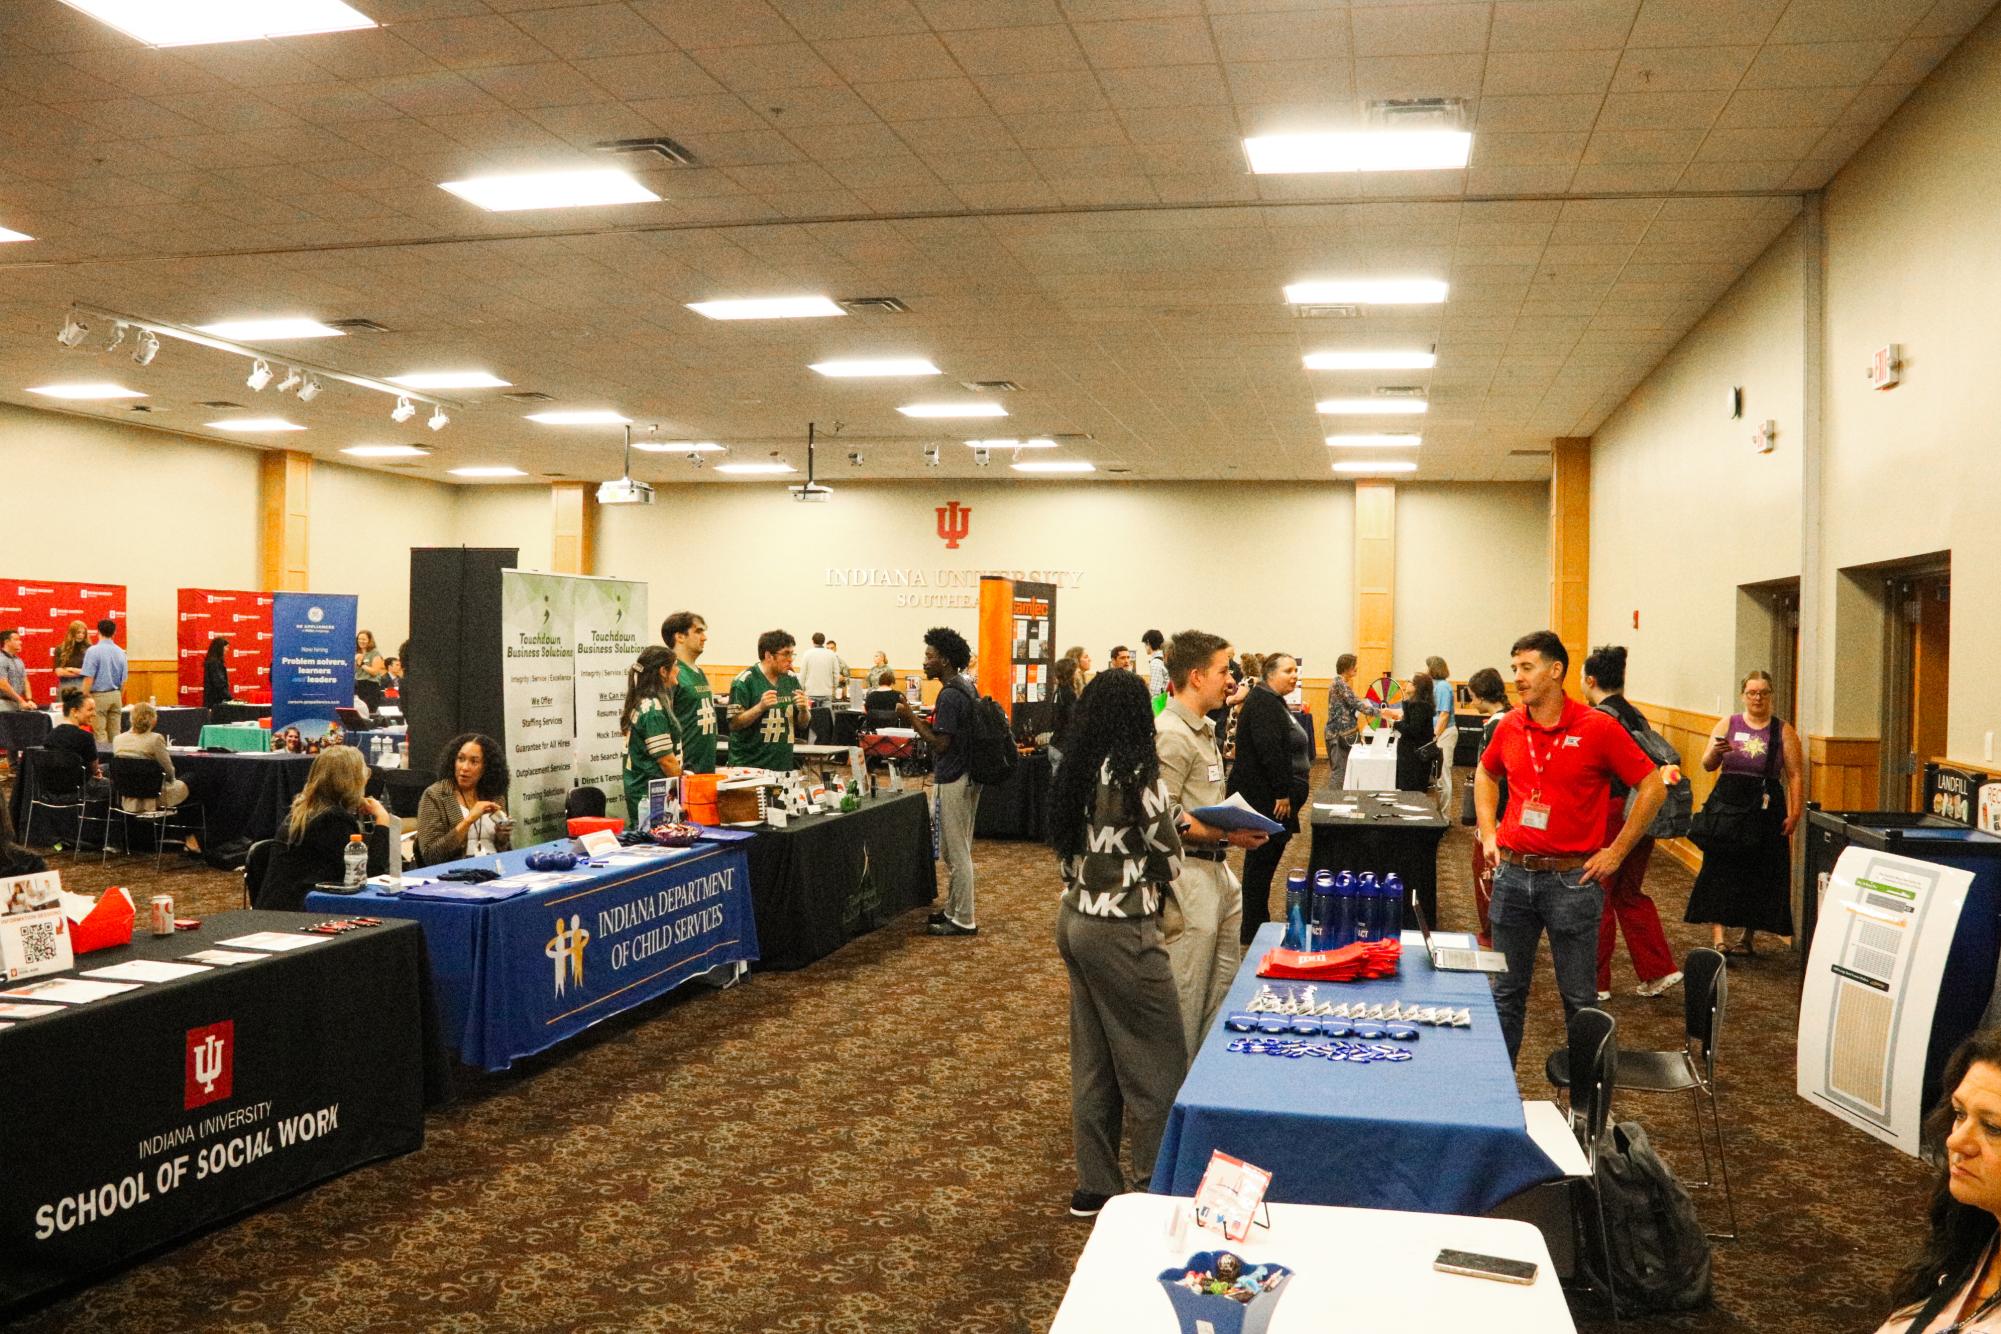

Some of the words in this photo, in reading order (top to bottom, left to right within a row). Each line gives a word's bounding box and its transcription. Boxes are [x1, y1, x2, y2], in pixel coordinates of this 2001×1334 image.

[824, 568, 929, 588] INDIANA
[520, 633, 562, 645] Touchdown
[591, 630, 636, 642] Touchdown
[507, 646, 540, 658] Business
[541, 646, 574, 658] Solutions
[577, 643, 613, 654] Business
[282, 657, 316, 665] Problem
[316, 658, 348, 666] solvers,
[298, 666, 331, 674] learners
[581, 670, 600, 679] Integrity
[604, 669, 621, 677] Service
[307, 675, 337, 683] leaders
[549, 673, 572, 682] Excellence
[531, 697, 540, 705] We
[541, 696, 553, 705] Offer
[599, 692, 607, 700] We
[609, 692, 619, 700] Can
[597, 709, 617, 717] Resume
[522, 718, 542, 728] Staffing
[543, 717, 563, 726] Services
[596, 731, 610, 739] Mock
[515, 741, 541, 753] Guarantee
[549, 740, 557, 749] All
[557, 740, 571, 748] Hires
[590, 753, 600, 762] Job
[601, 752, 619, 761] Search
[516, 765, 550, 778] Outplacement
[550, 763, 571, 773] Services
[582, 775, 599, 785] Direct
[1937, 773, 1968, 795] LANDFILL
[522, 790, 543, 801] Training
[598, 895, 656, 940] INDIANA
[658, 868, 735, 916] DEPARTMENT
[1078, 888, 1128, 918] MK
[611, 941, 631, 970] OF
[632, 924, 673, 962] CHILD
[674, 903, 723, 945] SERVICES
[139, 1124, 195, 1159] INDIANA
[200, 1100, 273, 1139] UNIVERSITY
[35, 1171, 150, 1240] SCHOOL
[156, 1155, 190, 1194] OF
[196, 1127, 273, 1181] SOCIAL
[277, 1102, 340, 1148] WORK
